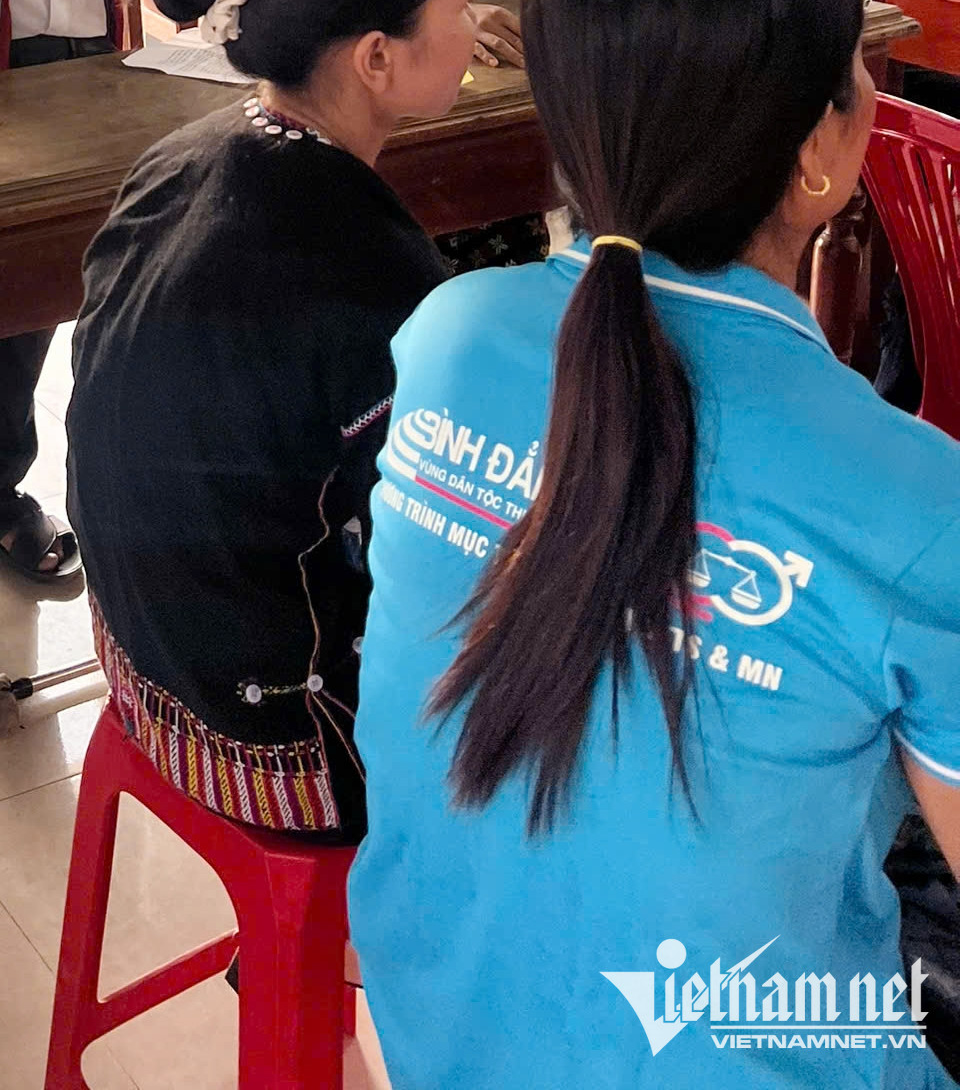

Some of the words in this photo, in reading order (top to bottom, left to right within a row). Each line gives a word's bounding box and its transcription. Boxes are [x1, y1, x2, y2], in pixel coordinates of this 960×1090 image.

[418, 459, 447, 483] VÙNG
[448, 475, 475, 497] DÂN
[476, 487, 503, 510] TỘC
[405, 497, 447, 537] TRÌNH
[447, 522, 489, 558] MỤC
[708, 644, 730, 672] &
[737, 654, 783, 691] MN
